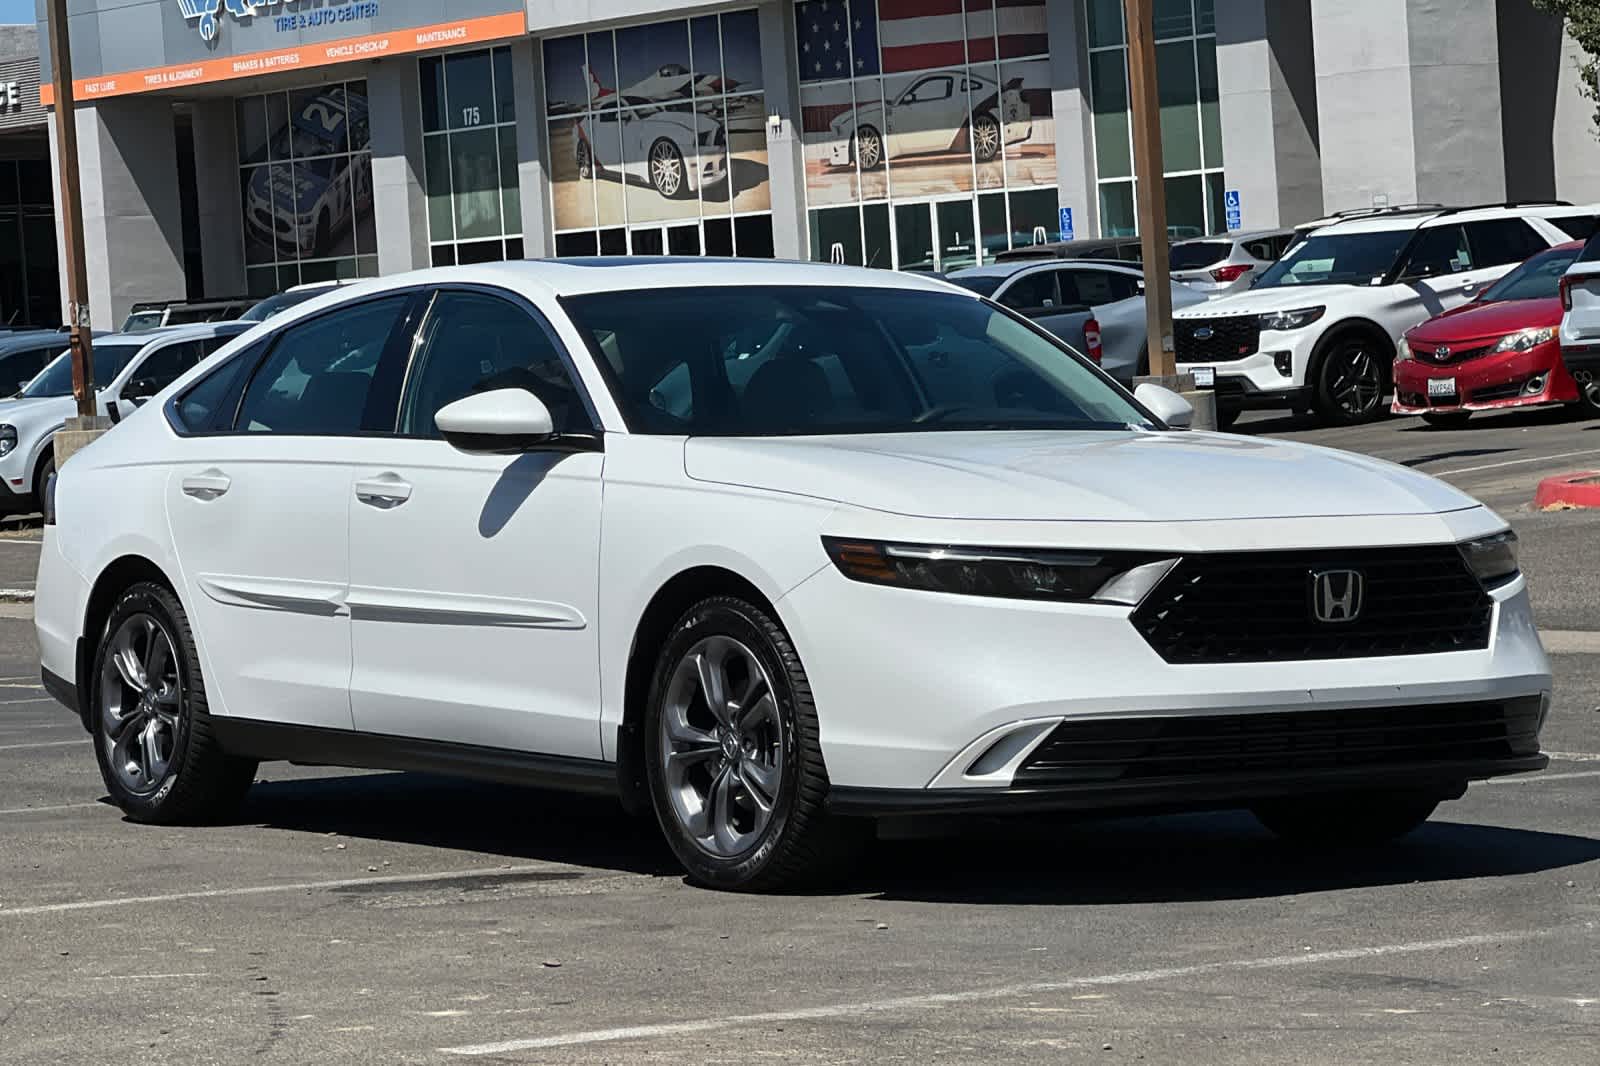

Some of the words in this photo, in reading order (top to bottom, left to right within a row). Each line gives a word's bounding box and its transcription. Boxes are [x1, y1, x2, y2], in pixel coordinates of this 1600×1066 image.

[274, 16, 297, 32] TIRE
[299, 14, 306, 28] &
[308, 9, 336, 26] AUTO
[338, 2, 379, 22] CENTER
[416, 27, 466, 44] MAINTENANCE
[326, 44, 354, 57] VEHICLE
[355, 39, 389, 53] CHECK-UP
[233, 59, 258, 72] BRAKES
[265, 53, 299, 68] BATTERIES
[144, 73, 161, 85] TIRES
[169, 68, 203, 82] ALIGNMENT
[84, 82, 99, 93] FAST
[463, 107, 480, 126] 175
